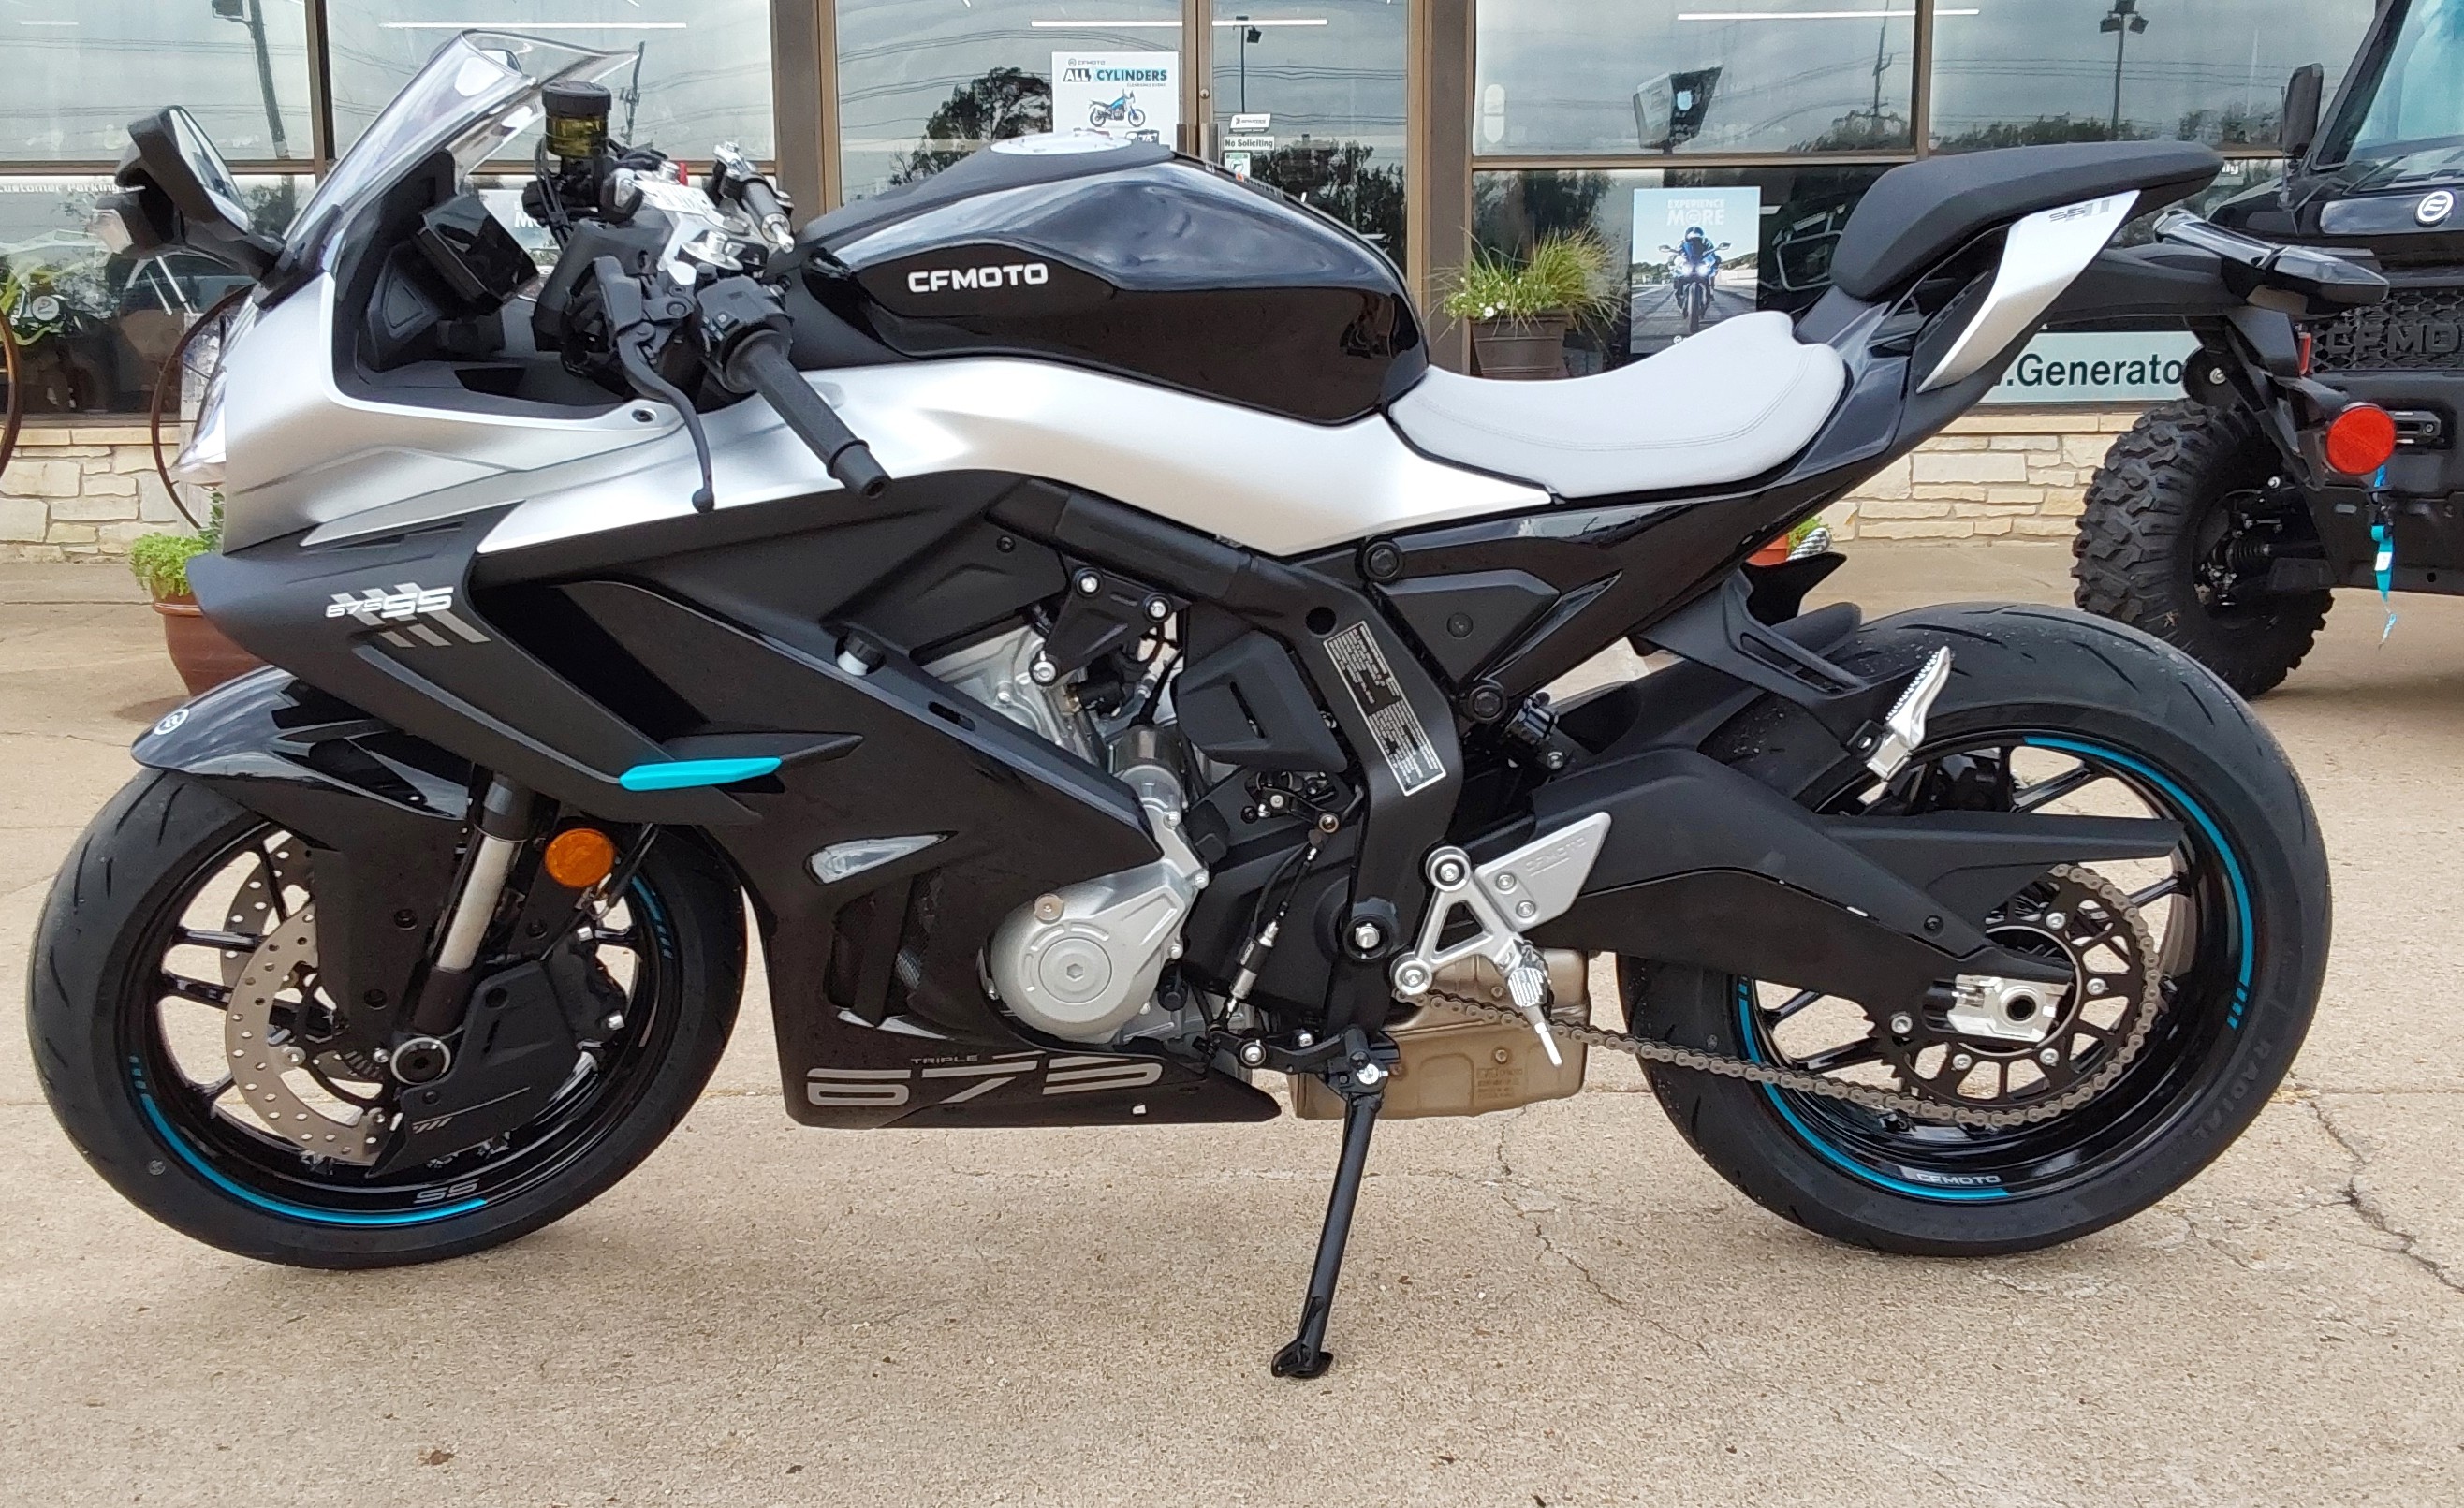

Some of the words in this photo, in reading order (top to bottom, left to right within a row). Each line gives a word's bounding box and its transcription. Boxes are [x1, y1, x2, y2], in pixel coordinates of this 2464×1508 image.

[1063, 68, 1091, 81] ALL
[1096, 69, 1167, 81] CYLINDERS
[1225, 139, 1236, 147] No
[1237, 139, 1273, 148] Soliciting
[1667, 199, 1724, 209] EXPERIENCE
[907, 263, 1049, 293] CFMOTO
[1994, 353, 2184, 387] .Generato
[910, 1054, 978, 1065] TRIPLE
[807, 1056, 1163, 1106] 675
[1916, 1173, 2002, 1186] CFMOTO
[414, 1178, 480, 1204] SS
